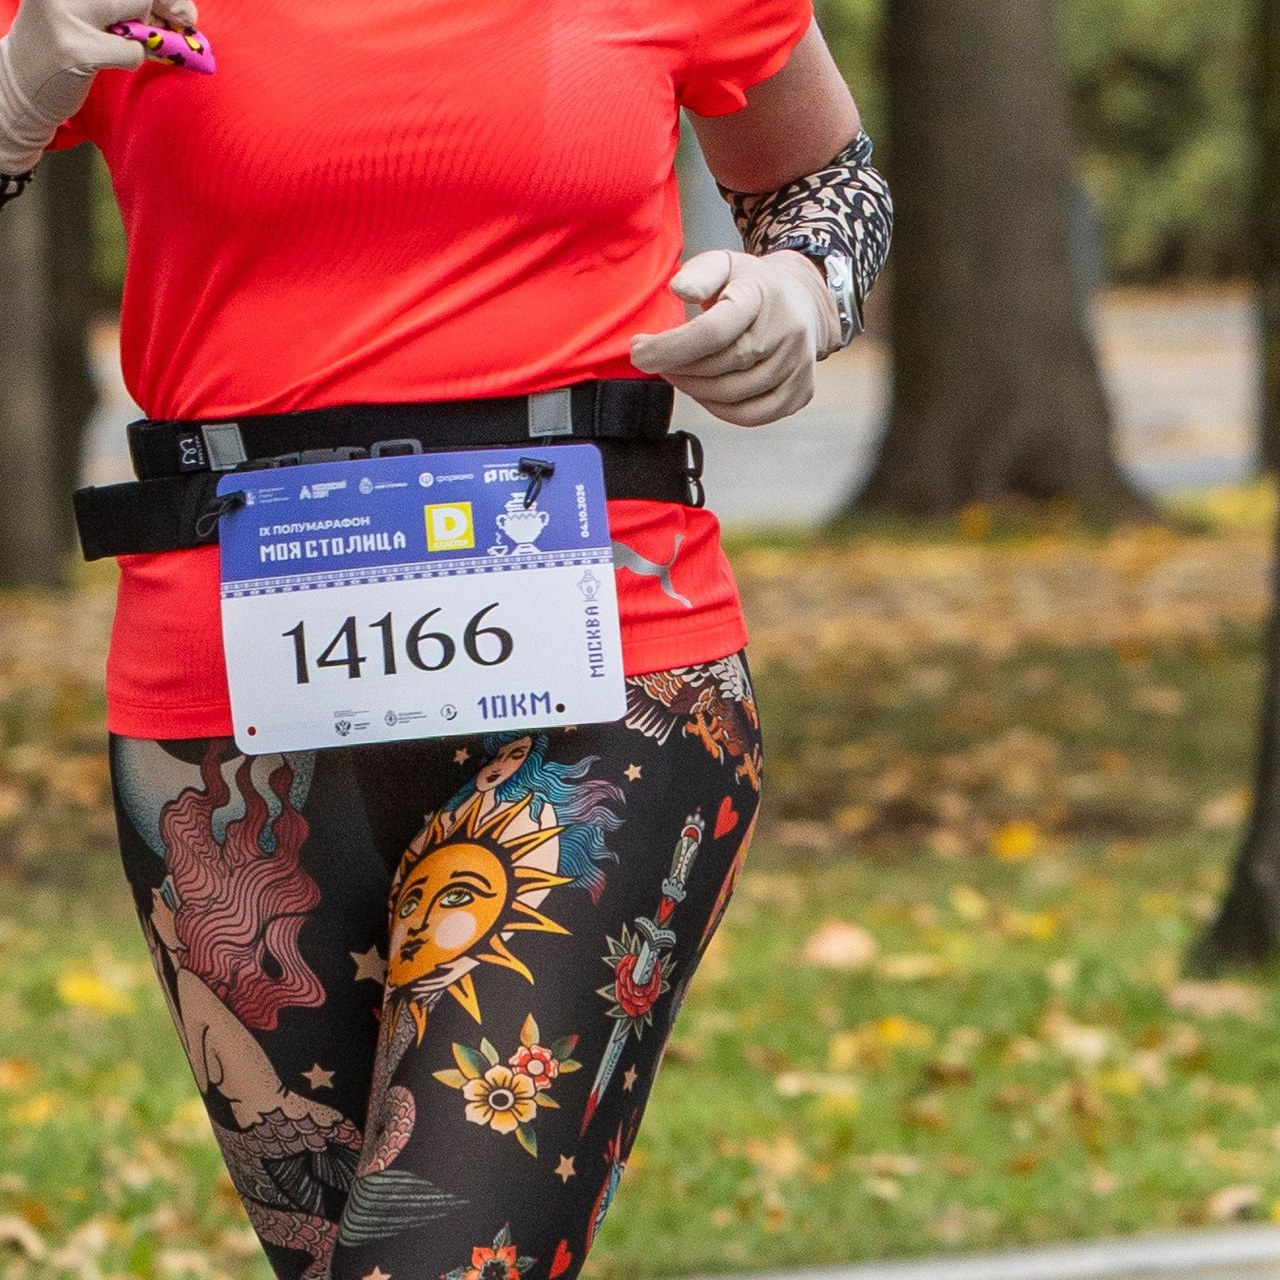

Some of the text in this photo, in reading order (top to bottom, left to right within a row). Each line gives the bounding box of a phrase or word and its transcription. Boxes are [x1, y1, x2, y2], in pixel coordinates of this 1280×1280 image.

[258, 516, 371, 537] IX ПОЛУМАРАФОН
[432, 507, 468, 540] D
[259, 530, 407, 563] МОЯ СТОЛИЦА
[282, 602, 514, 684] 14166
[585, 605, 605, 678] МОСКВА
